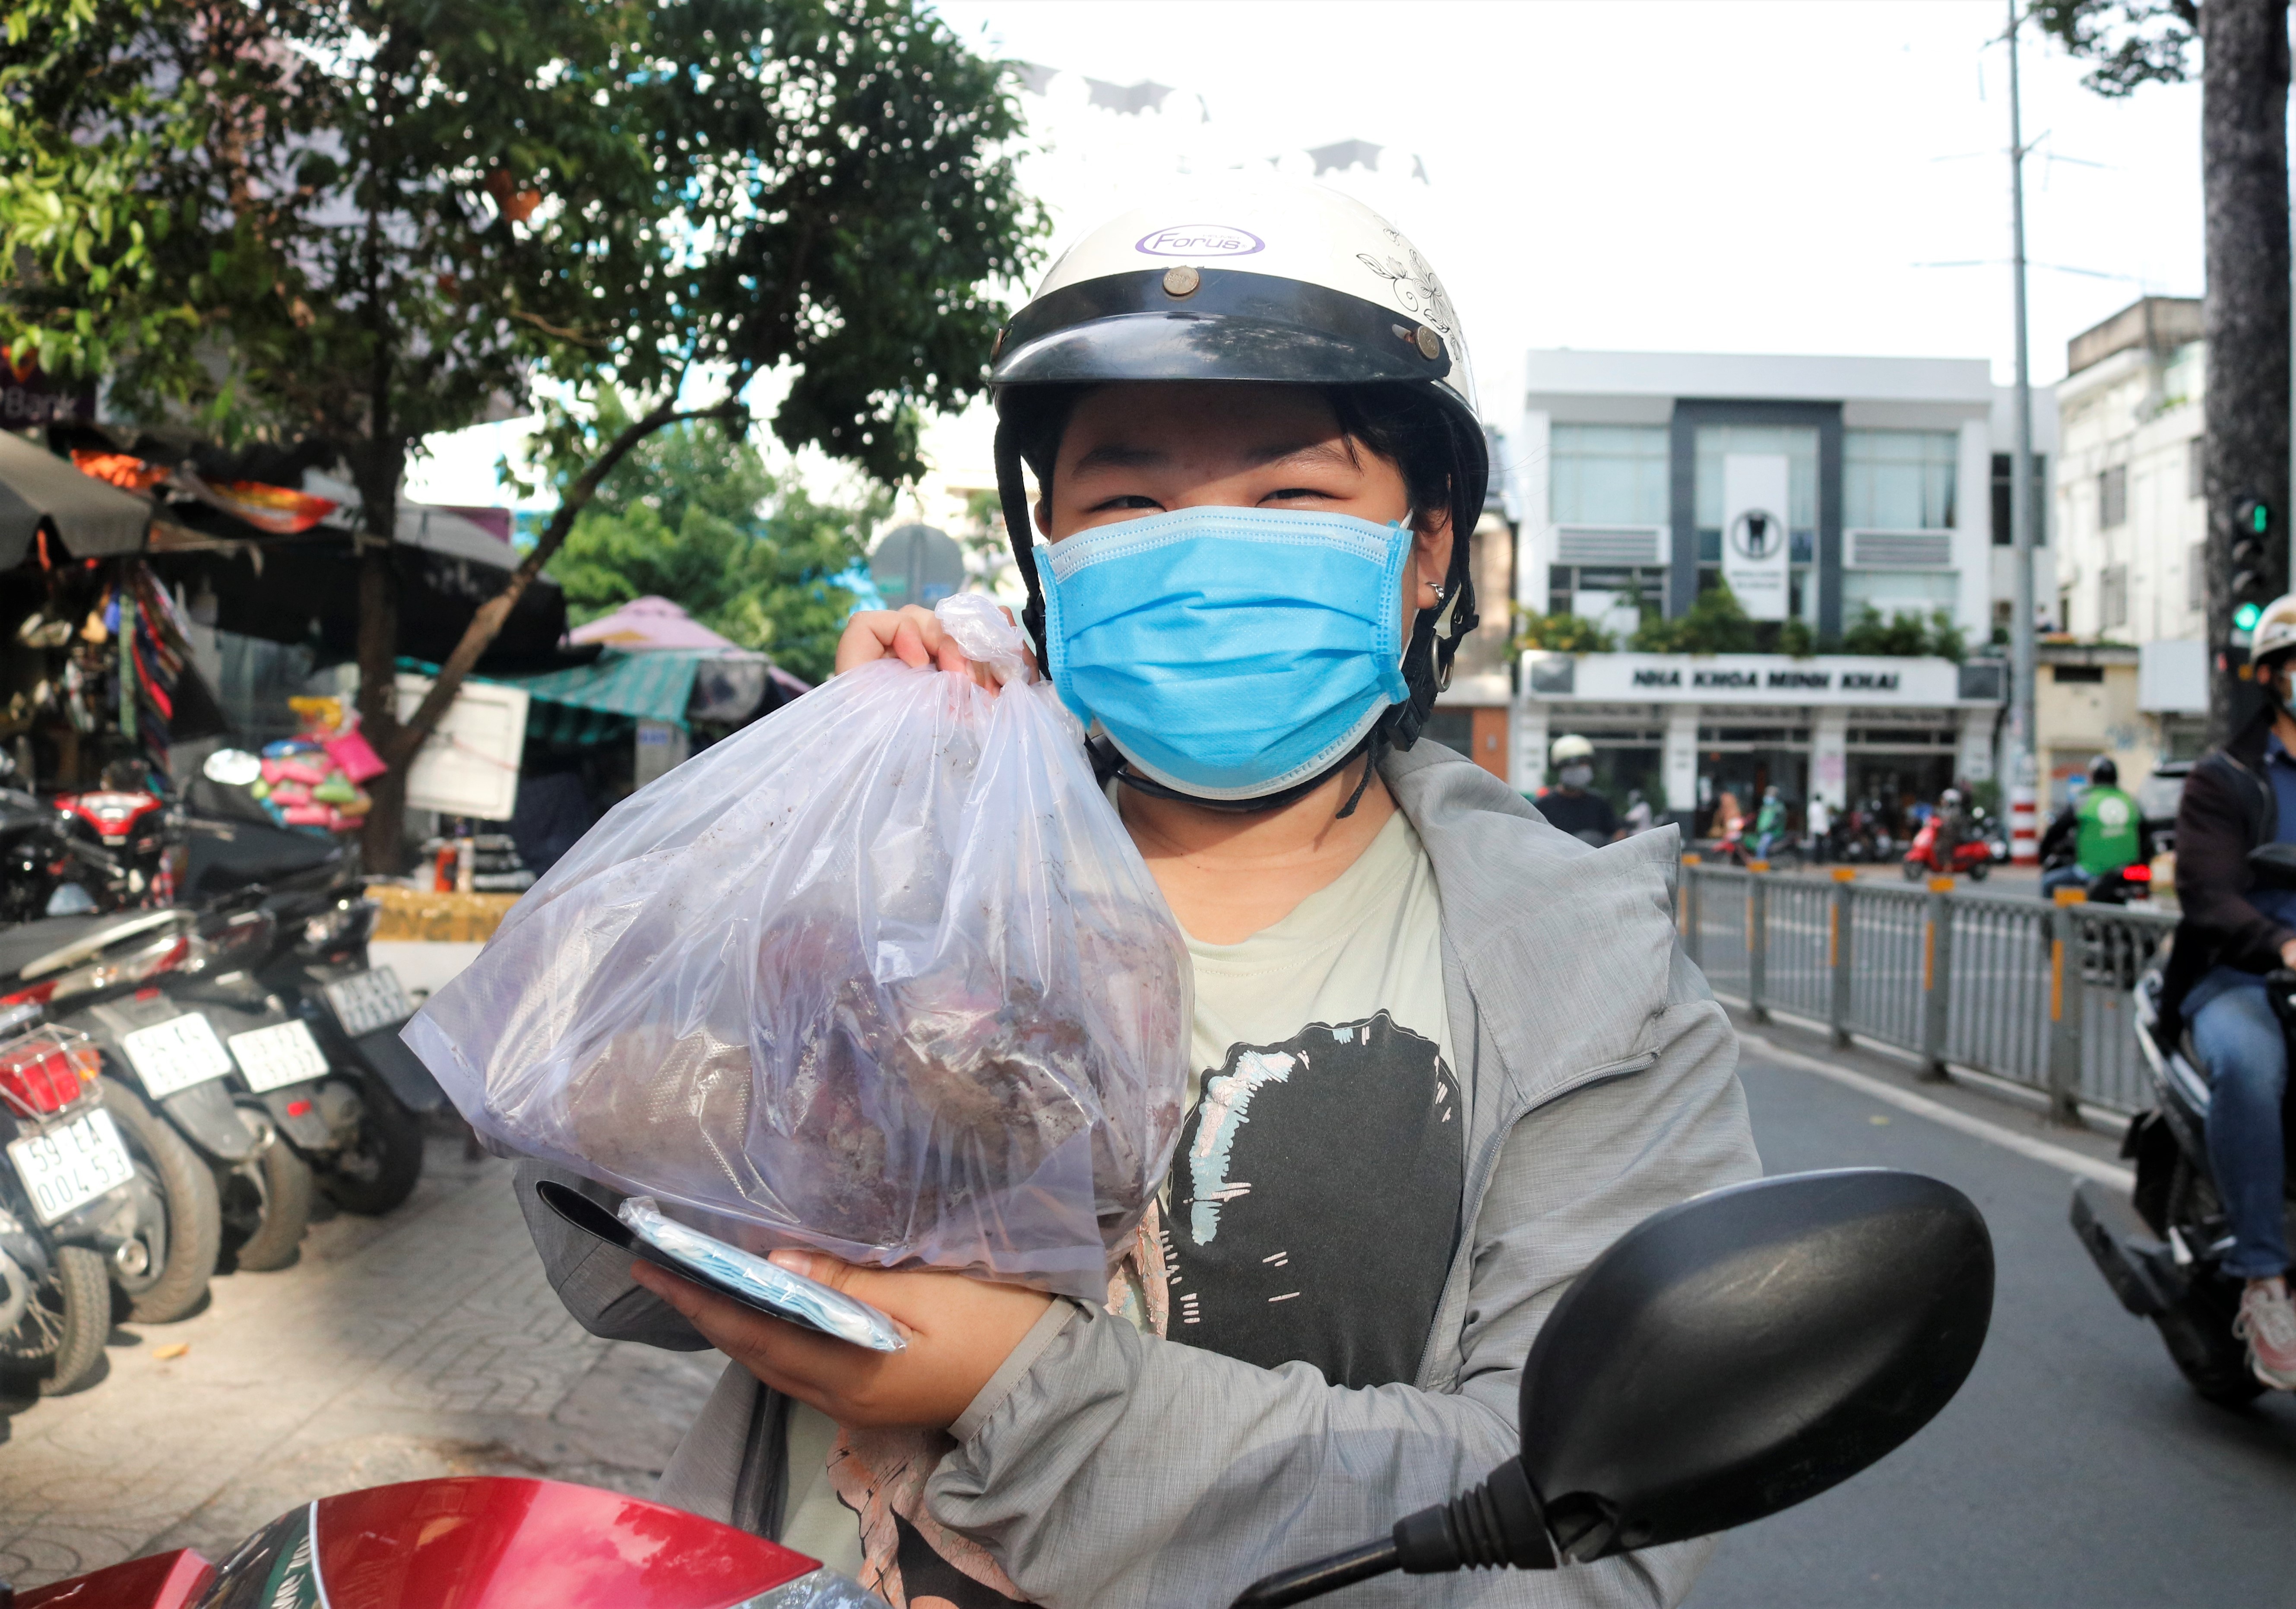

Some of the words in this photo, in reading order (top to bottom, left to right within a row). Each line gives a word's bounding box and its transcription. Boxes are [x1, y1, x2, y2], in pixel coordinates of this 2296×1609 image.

[1152, 232, 1241, 250] Forus
[27, 1136, 62, 1172] 59
[37, 1148, 126, 1212] 00453
